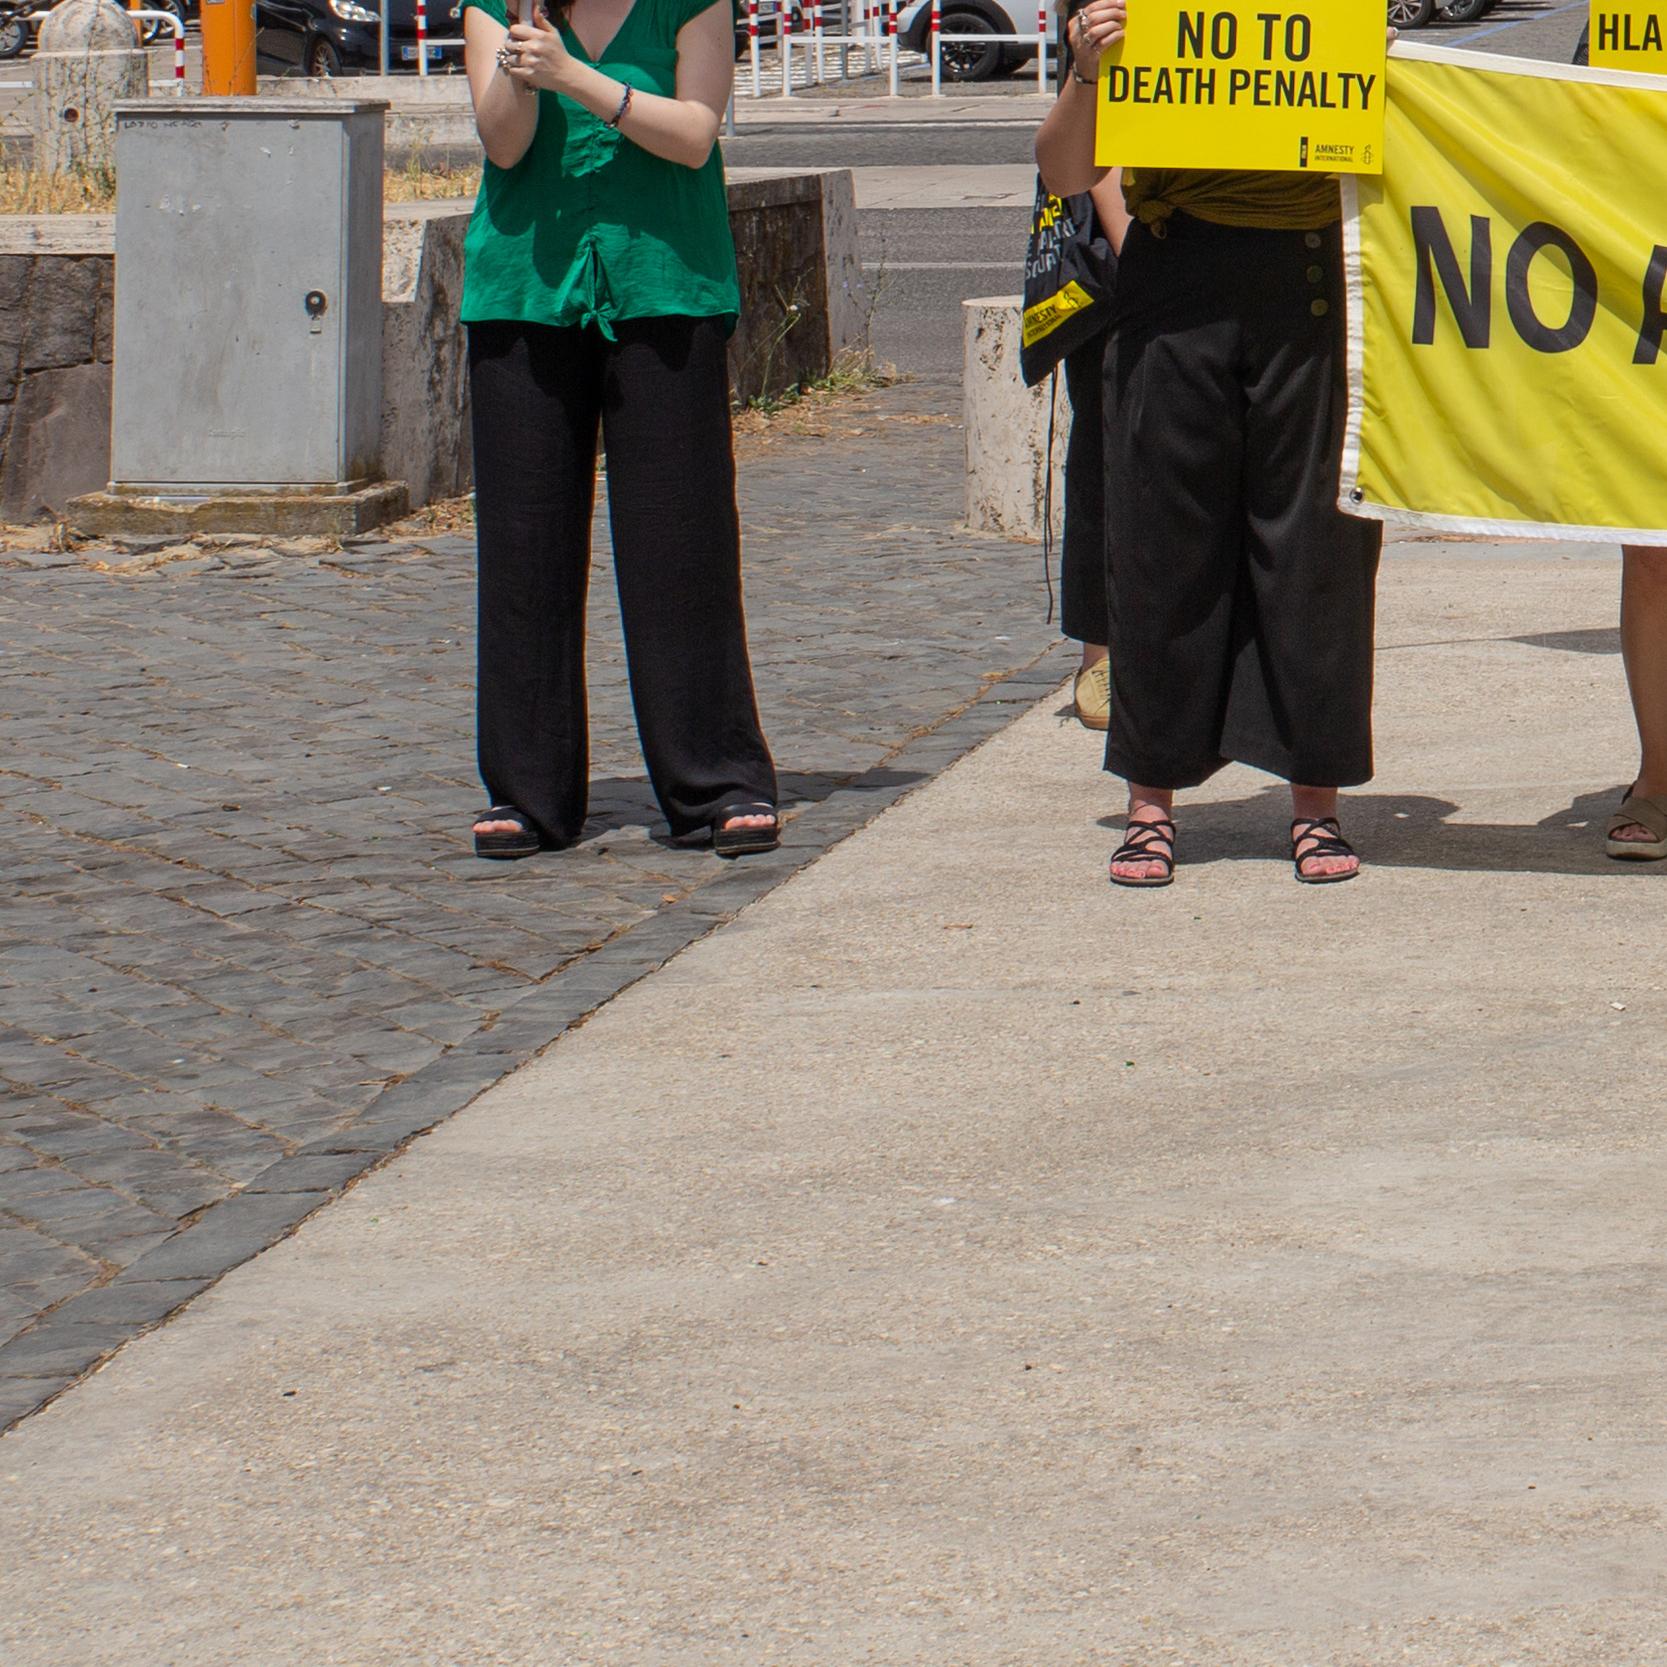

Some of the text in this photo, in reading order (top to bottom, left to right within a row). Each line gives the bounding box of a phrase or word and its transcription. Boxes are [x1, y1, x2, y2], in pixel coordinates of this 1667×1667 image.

[1177, 11, 1312, 62] NO TO
[1598, 14, 1663, 51] HLA
[1108, 65, 1376, 110] DEATH PENALTY
[1315, 144, 1354, 155] AMNESTY
[1410, 206, 1598, 354] NO
